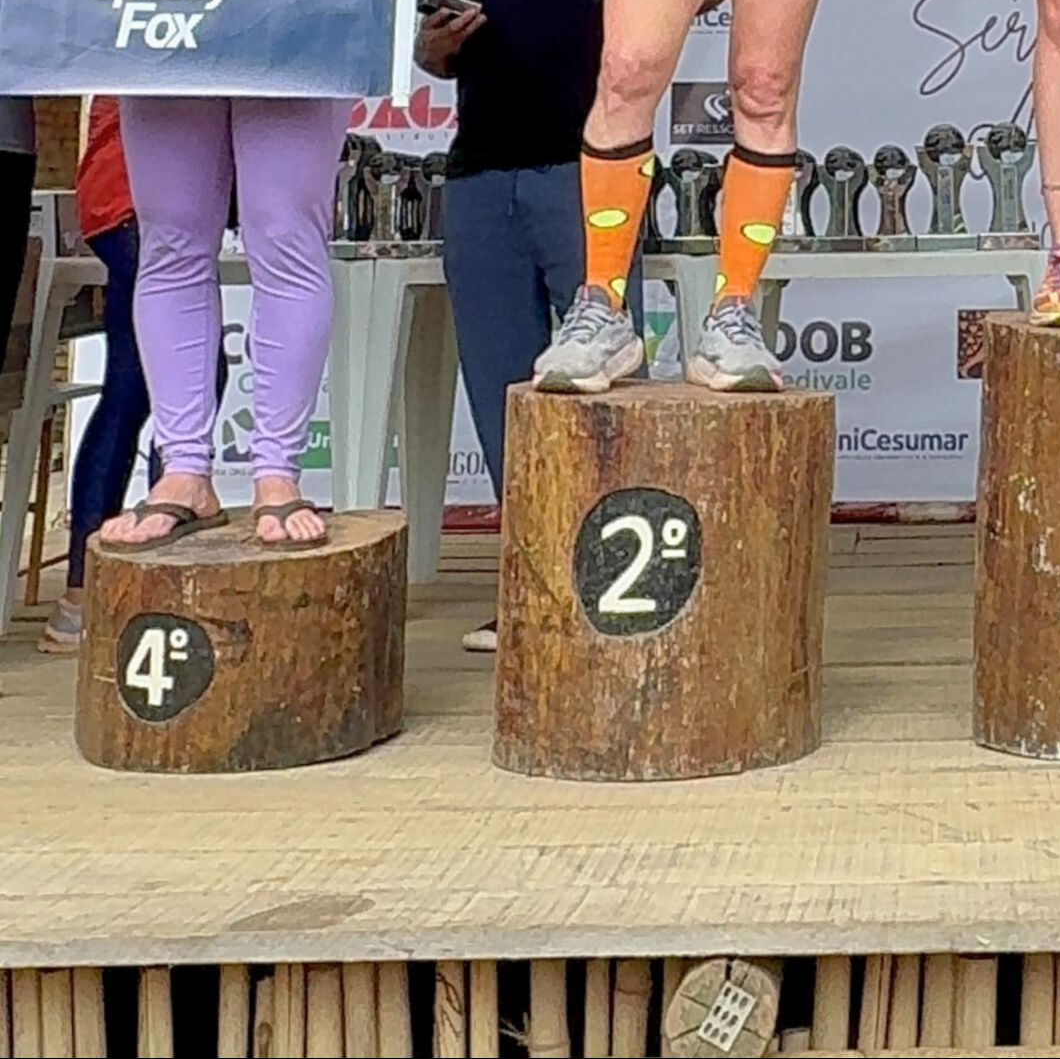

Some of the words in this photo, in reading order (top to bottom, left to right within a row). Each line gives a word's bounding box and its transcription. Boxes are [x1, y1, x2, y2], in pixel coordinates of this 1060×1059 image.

[114, 1, 205, 50] Fox
[672, 123, 694, 135] SET
[597, 515, 688, 614] 2º
[125, 627, 189, 707] 4º
